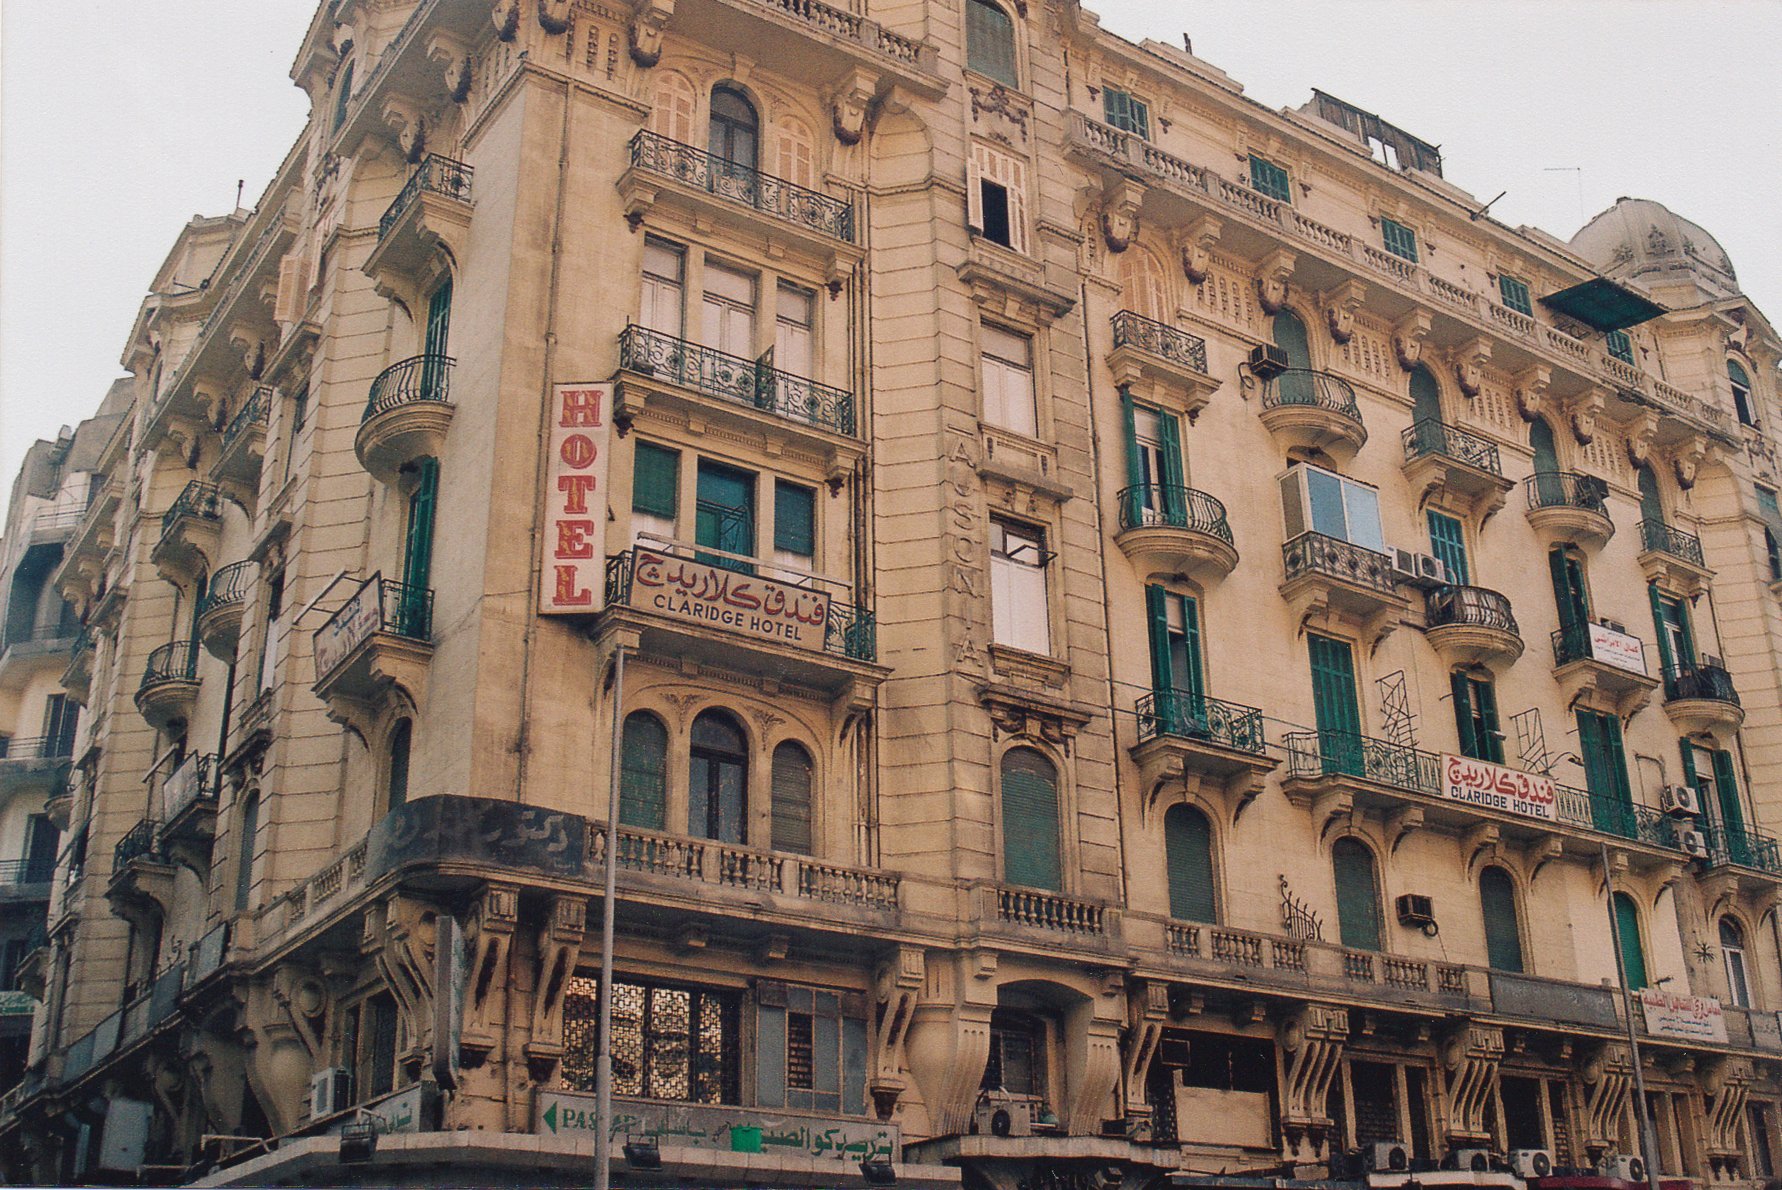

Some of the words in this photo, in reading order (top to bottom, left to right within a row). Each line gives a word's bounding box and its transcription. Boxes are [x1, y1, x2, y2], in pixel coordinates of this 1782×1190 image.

[551, 389, 603, 607] HOTEL
[653, 593, 744, 628] CLARIDGE
[750, 618, 802, 641] HOTEL
[762, 585, 826, 626] فندق
[1450, 785, 1508, 809] CLARIDGE
[1513, 799, 1550, 818] HOTEL
[1516, 772, 1555, 805] فندق
